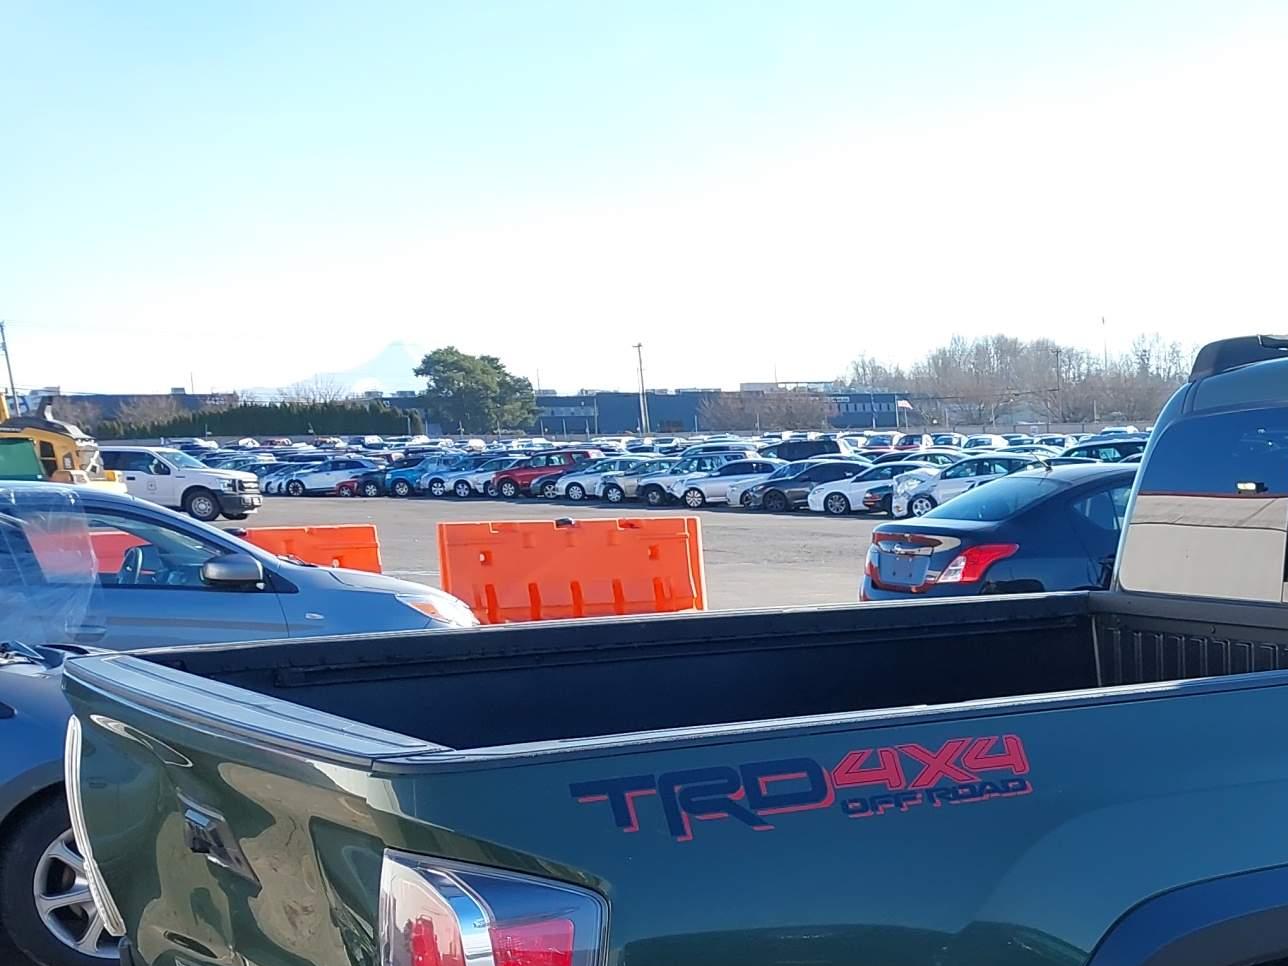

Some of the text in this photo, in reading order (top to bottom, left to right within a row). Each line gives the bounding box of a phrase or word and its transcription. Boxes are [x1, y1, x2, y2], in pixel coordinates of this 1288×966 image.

[568, 757, 836, 842] TRD
[840, 777, 1033, 818] OFF ROAD
